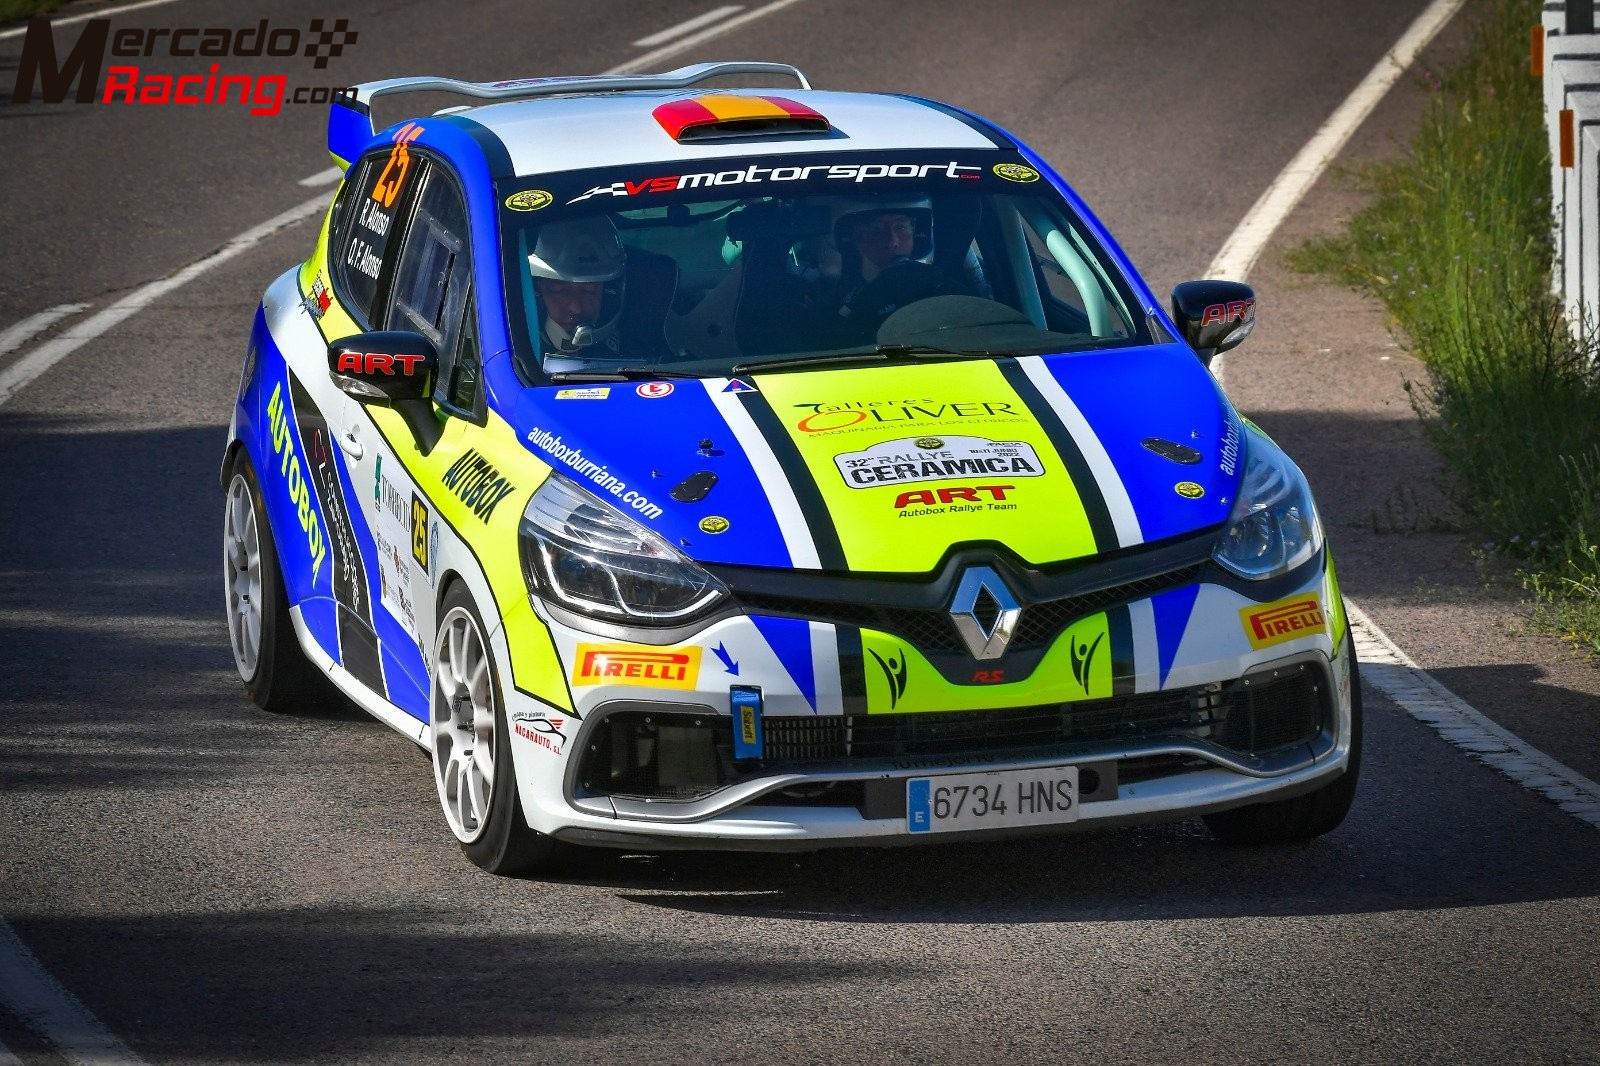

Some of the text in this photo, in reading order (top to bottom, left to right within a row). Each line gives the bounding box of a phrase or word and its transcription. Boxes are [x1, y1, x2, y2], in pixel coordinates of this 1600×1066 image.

[372, 122, 425, 207] 25
[338, 353, 425, 376] ART
[797, 402, 1021, 433] OLIVER
[850, 456, 1036, 484] CERAMICA
[876, 450, 955, 464] RALLYE
[441, 447, 517, 525] AUTOBOX
[527, 426, 663, 519] autoboxburriana.com
[894, 485, 1015, 508] ART
[898, 503, 1018, 518] Autobox Rallye Team
[413, 499, 427, 567] 25
[1249, 600, 1325, 640] PIRELLI
[581, 651, 690, 681] PIRELLI
[971, 669, 1005, 682] RS
[934, 779, 1073, 819] 6734 HNS
[915, 811, 924, 823] E
